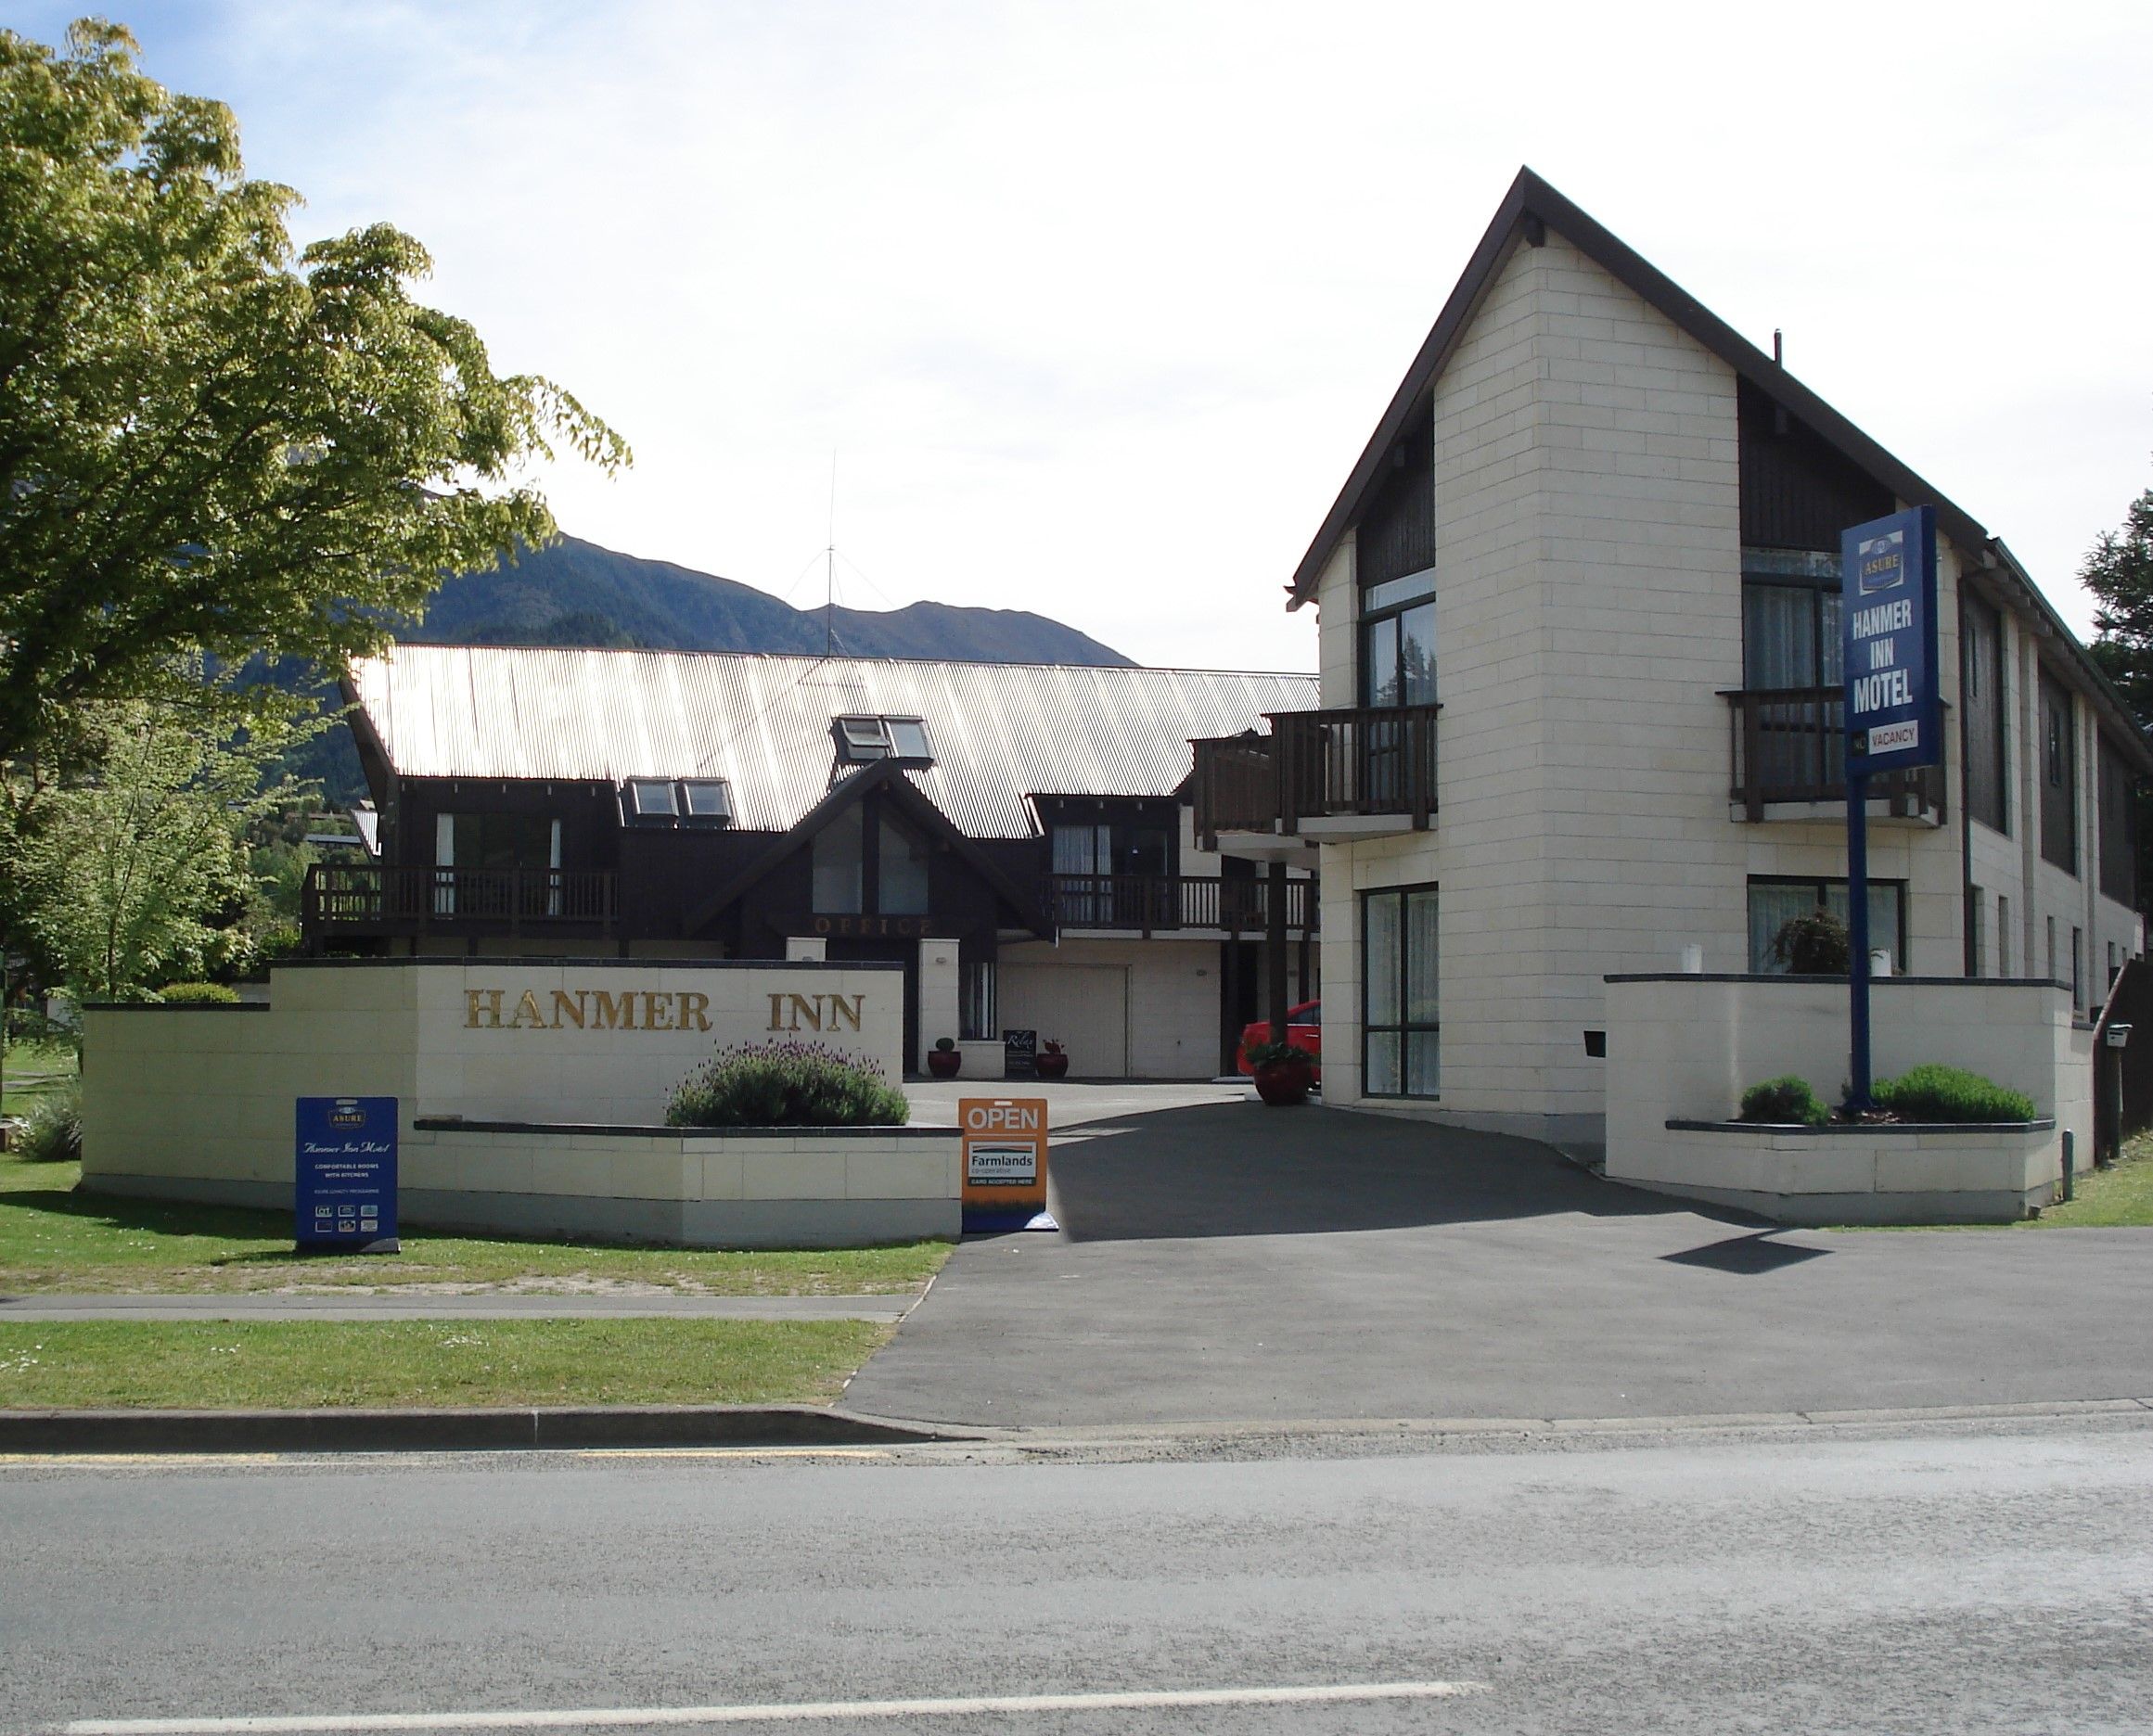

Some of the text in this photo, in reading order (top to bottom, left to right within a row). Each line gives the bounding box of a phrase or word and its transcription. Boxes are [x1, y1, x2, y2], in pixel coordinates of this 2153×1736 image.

[1864, 554, 1900, 575] ASURE
[1852, 598, 1912, 640] HANMER
[1870, 637, 1894, 670] INN
[1854, 669, 1914, 713] MOTEL
[1872, 727, 1915, 747] VACANCY
[815, 917, 932, 935] OFFICE
[464, 989, 865, 1032] HANMER INN
[968, 1107, 1039, 1130] OPEN
[971, 1155, 1032, 1167] Farmlands
